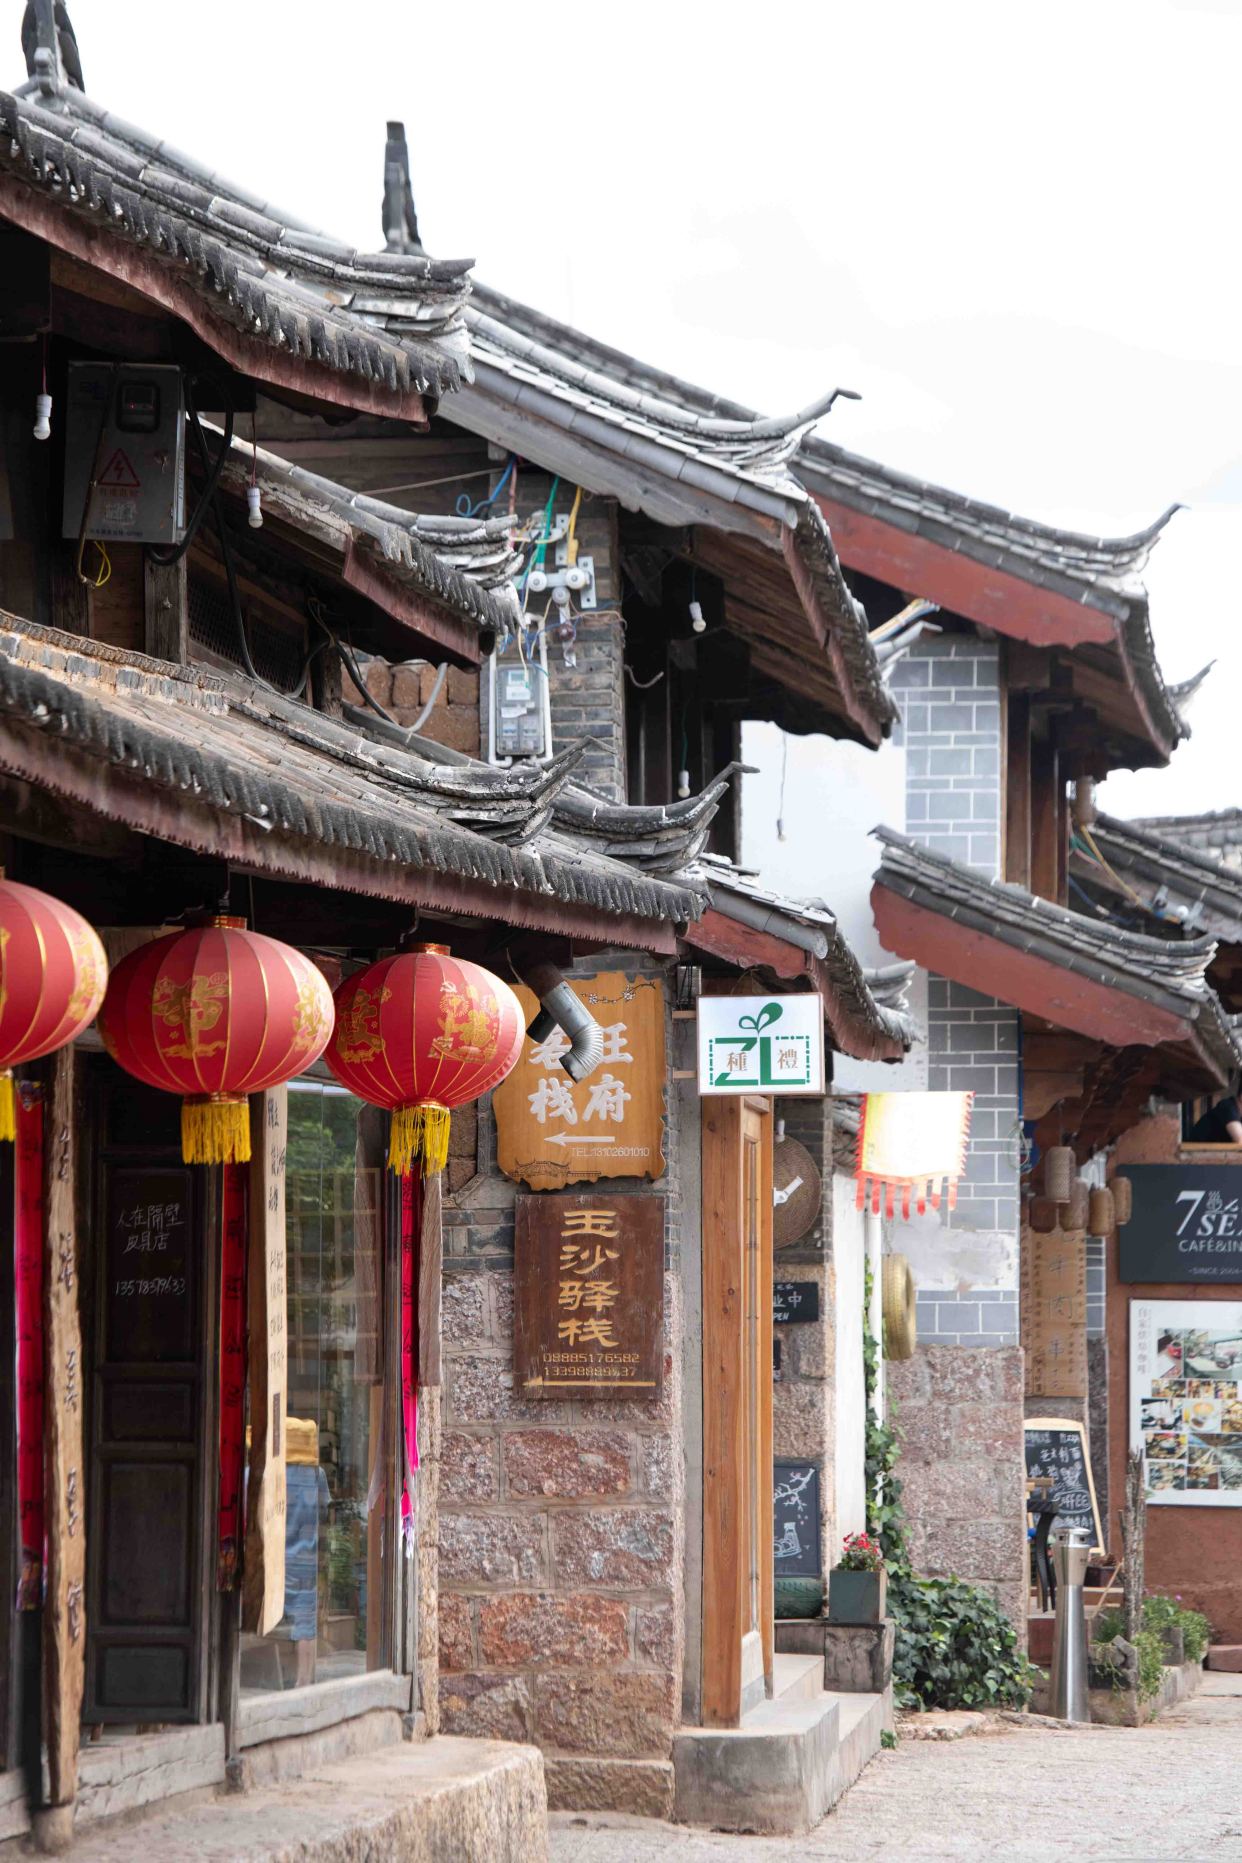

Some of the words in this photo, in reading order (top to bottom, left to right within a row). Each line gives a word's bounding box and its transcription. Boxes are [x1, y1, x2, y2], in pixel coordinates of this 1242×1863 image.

[1175, 1190, 1206, 1236] 7
[1196, 1213, 1242, 1237] SE
[558, 1210, 620, 1348] 玉沙驿栈
[543, 1352, 641, 1363] 08885176582
